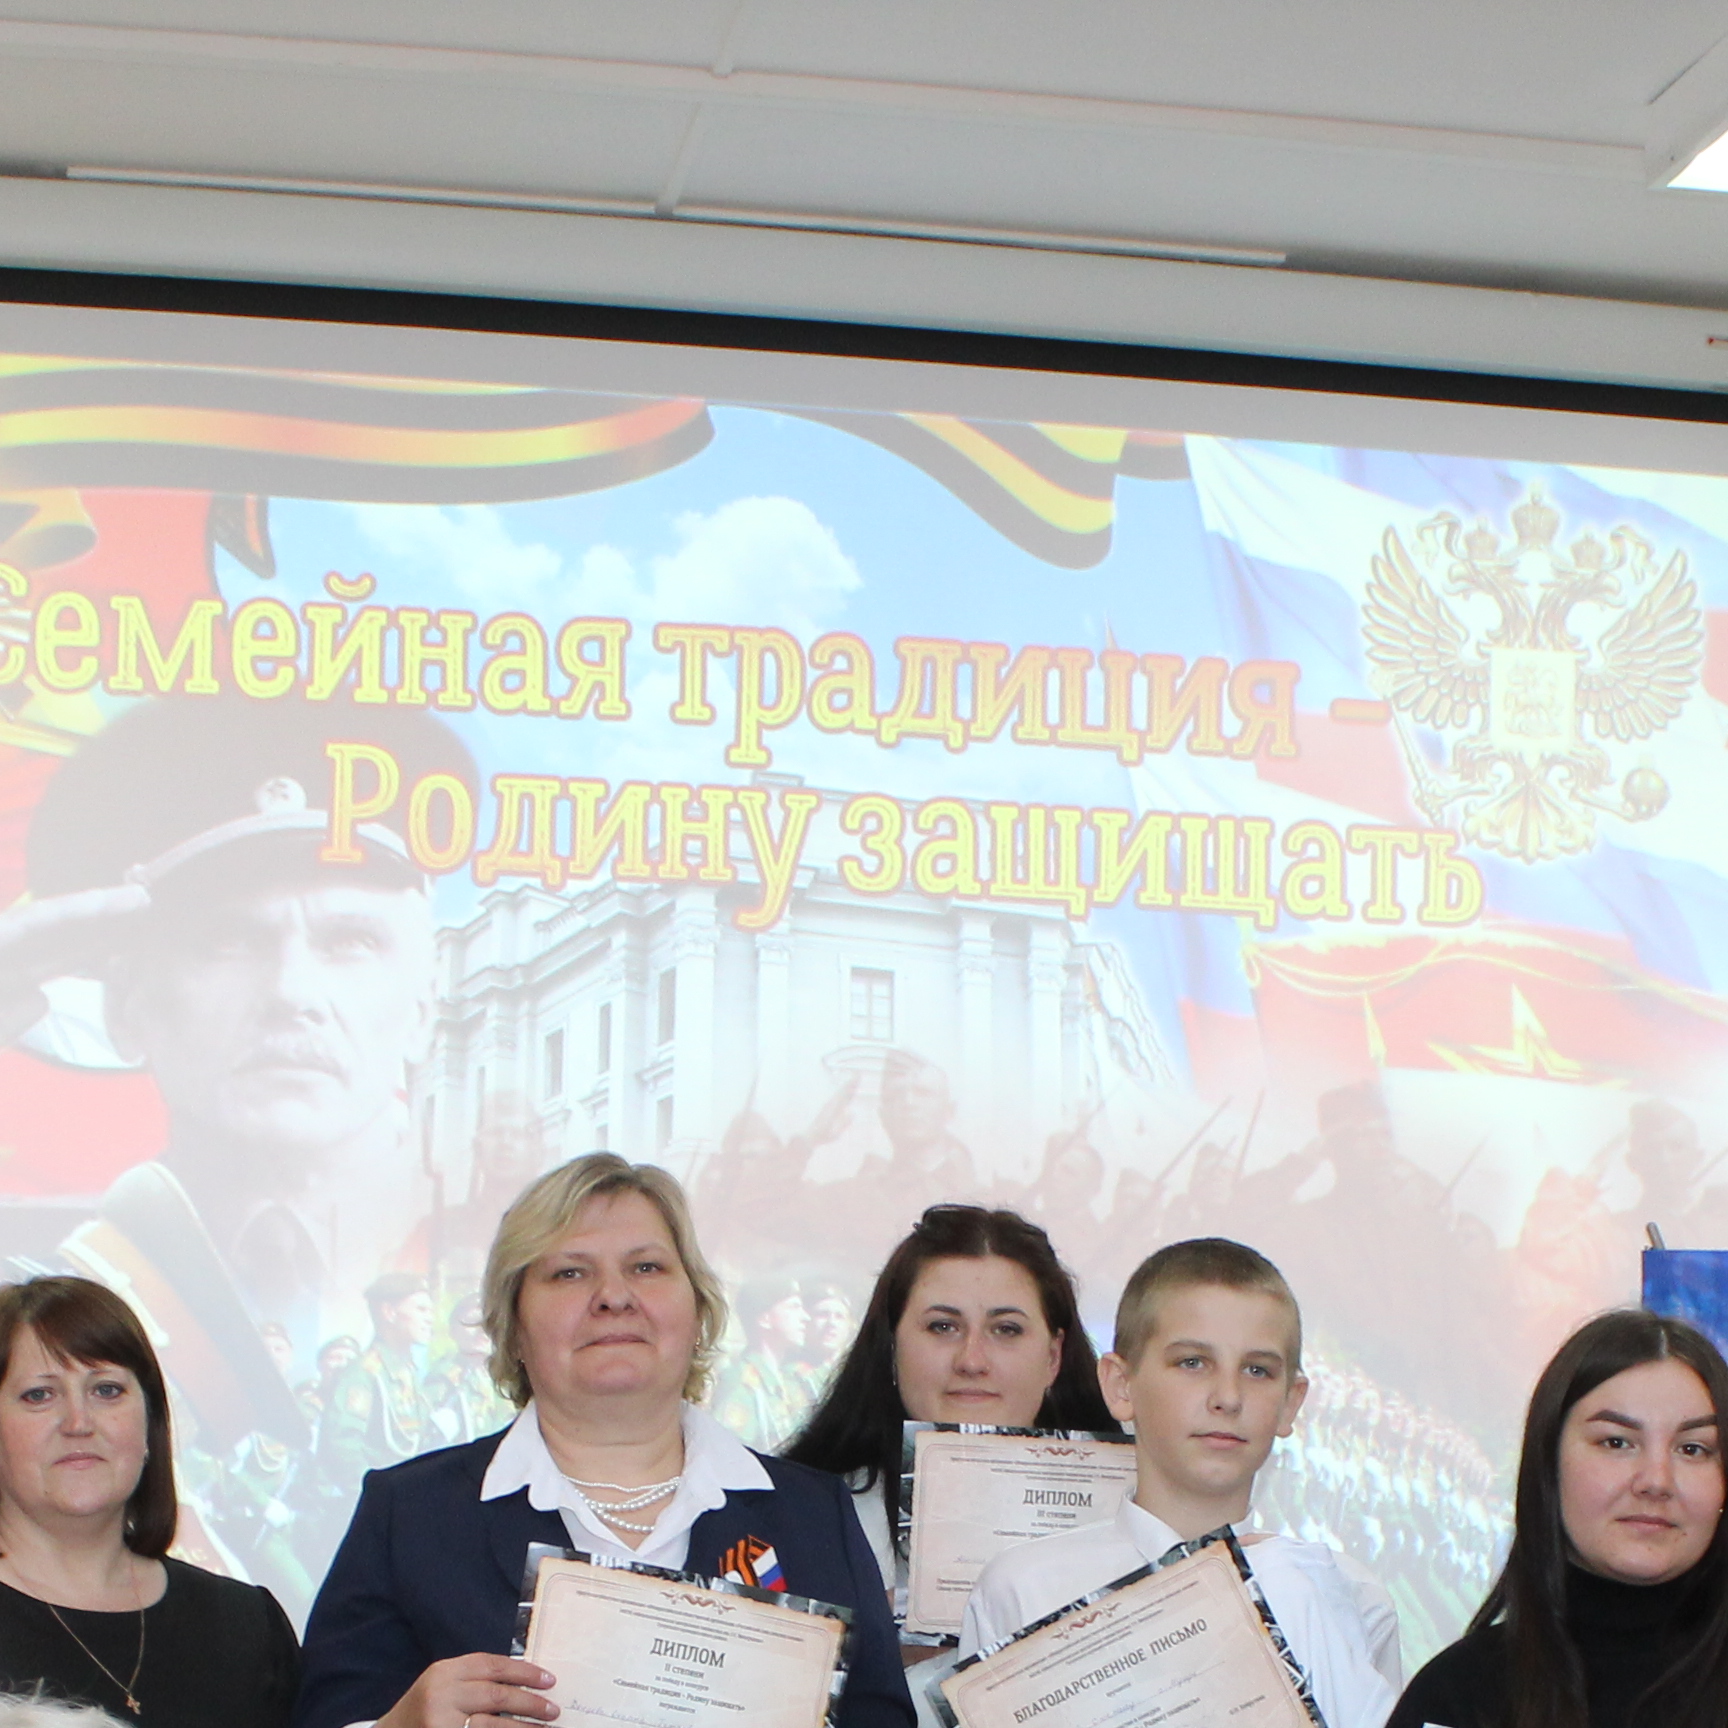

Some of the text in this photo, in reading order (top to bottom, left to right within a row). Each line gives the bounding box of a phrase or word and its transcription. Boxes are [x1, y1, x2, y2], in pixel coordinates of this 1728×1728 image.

[656, 619, 1301, 768] традиция
[320, 741, 1484, 930] Родину защищать
[1022, 1488, 1093, 1508] ДИПЛОМ
[649, 1637, 725, 1668] ДИПЛОМ
[1011, 1617, 1208, 1725] БЛАГОДАРСТВЕННОЕ ПИСЬМО
